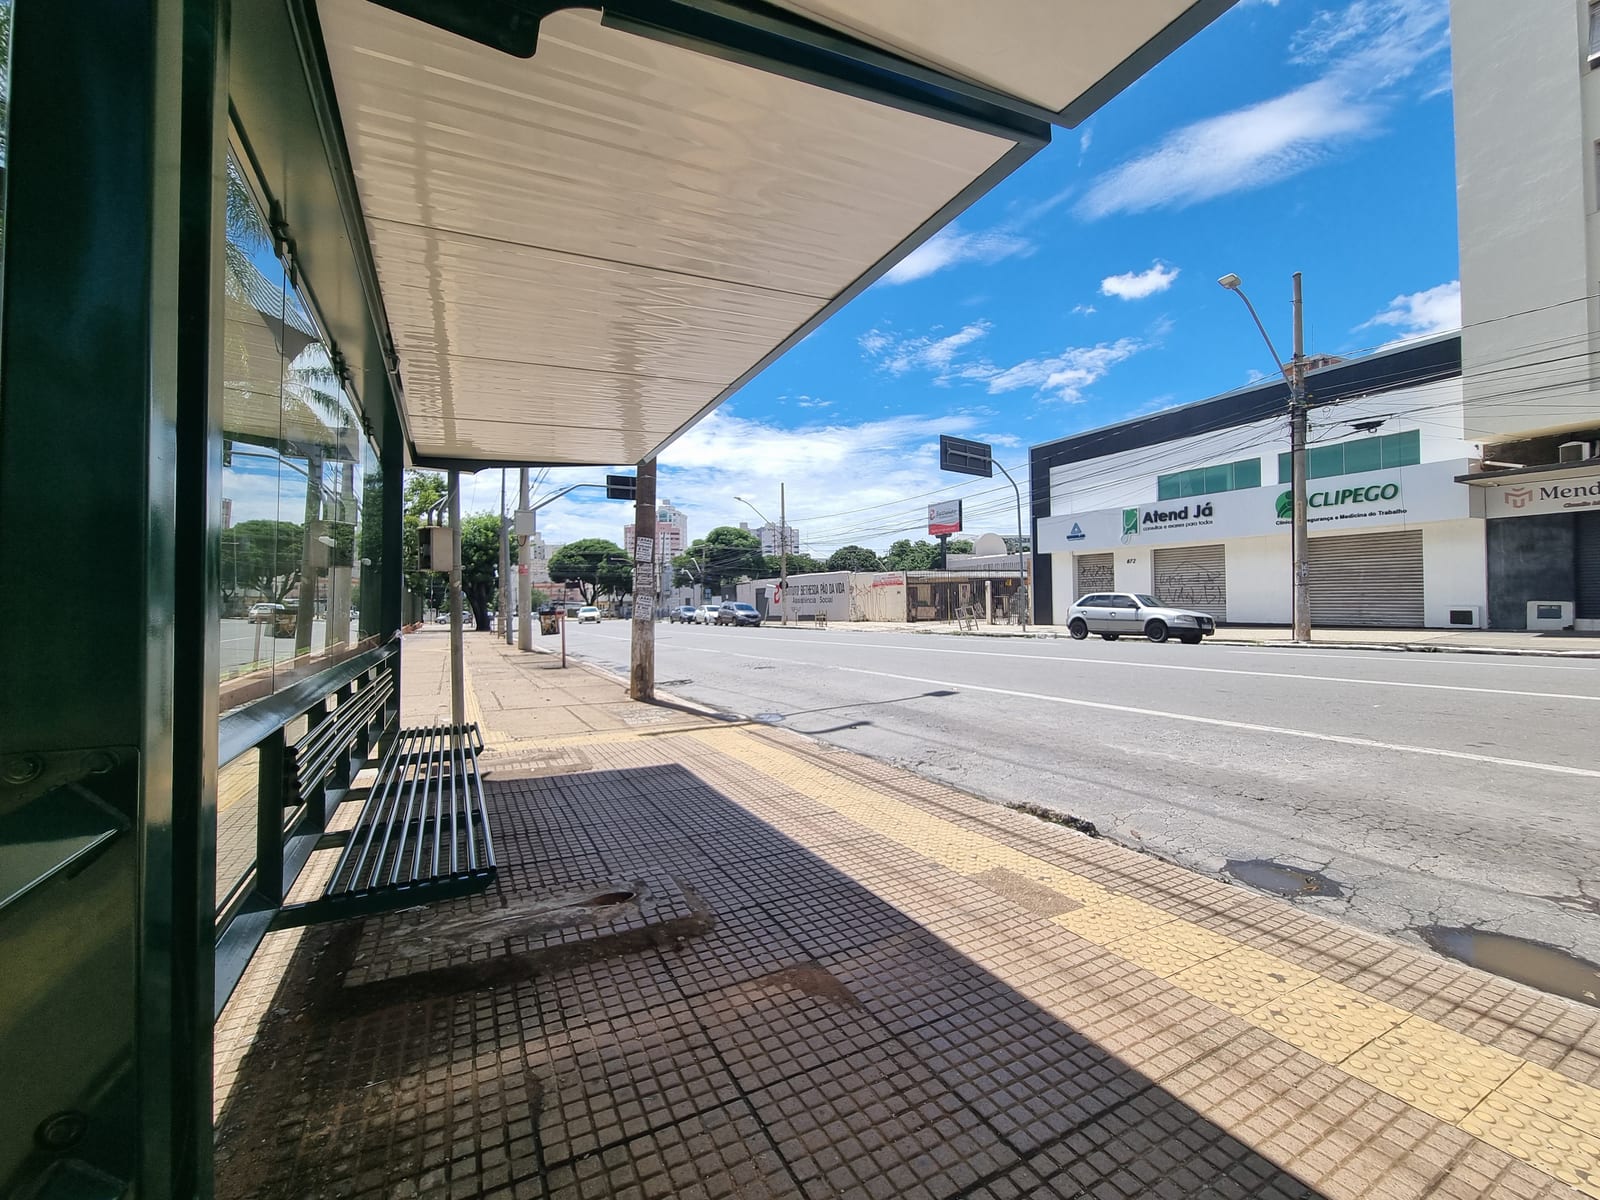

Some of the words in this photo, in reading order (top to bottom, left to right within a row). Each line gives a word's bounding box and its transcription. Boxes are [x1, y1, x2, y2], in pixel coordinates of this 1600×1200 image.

[1309, 483, 1399, 508] CLIPEGO
[1143, 506, 1188, 524] Atend
[1193, 502, 1213, 518] Já
[835, 582, 845, 594] VIDA
[819, 595, 833, 604] Social
